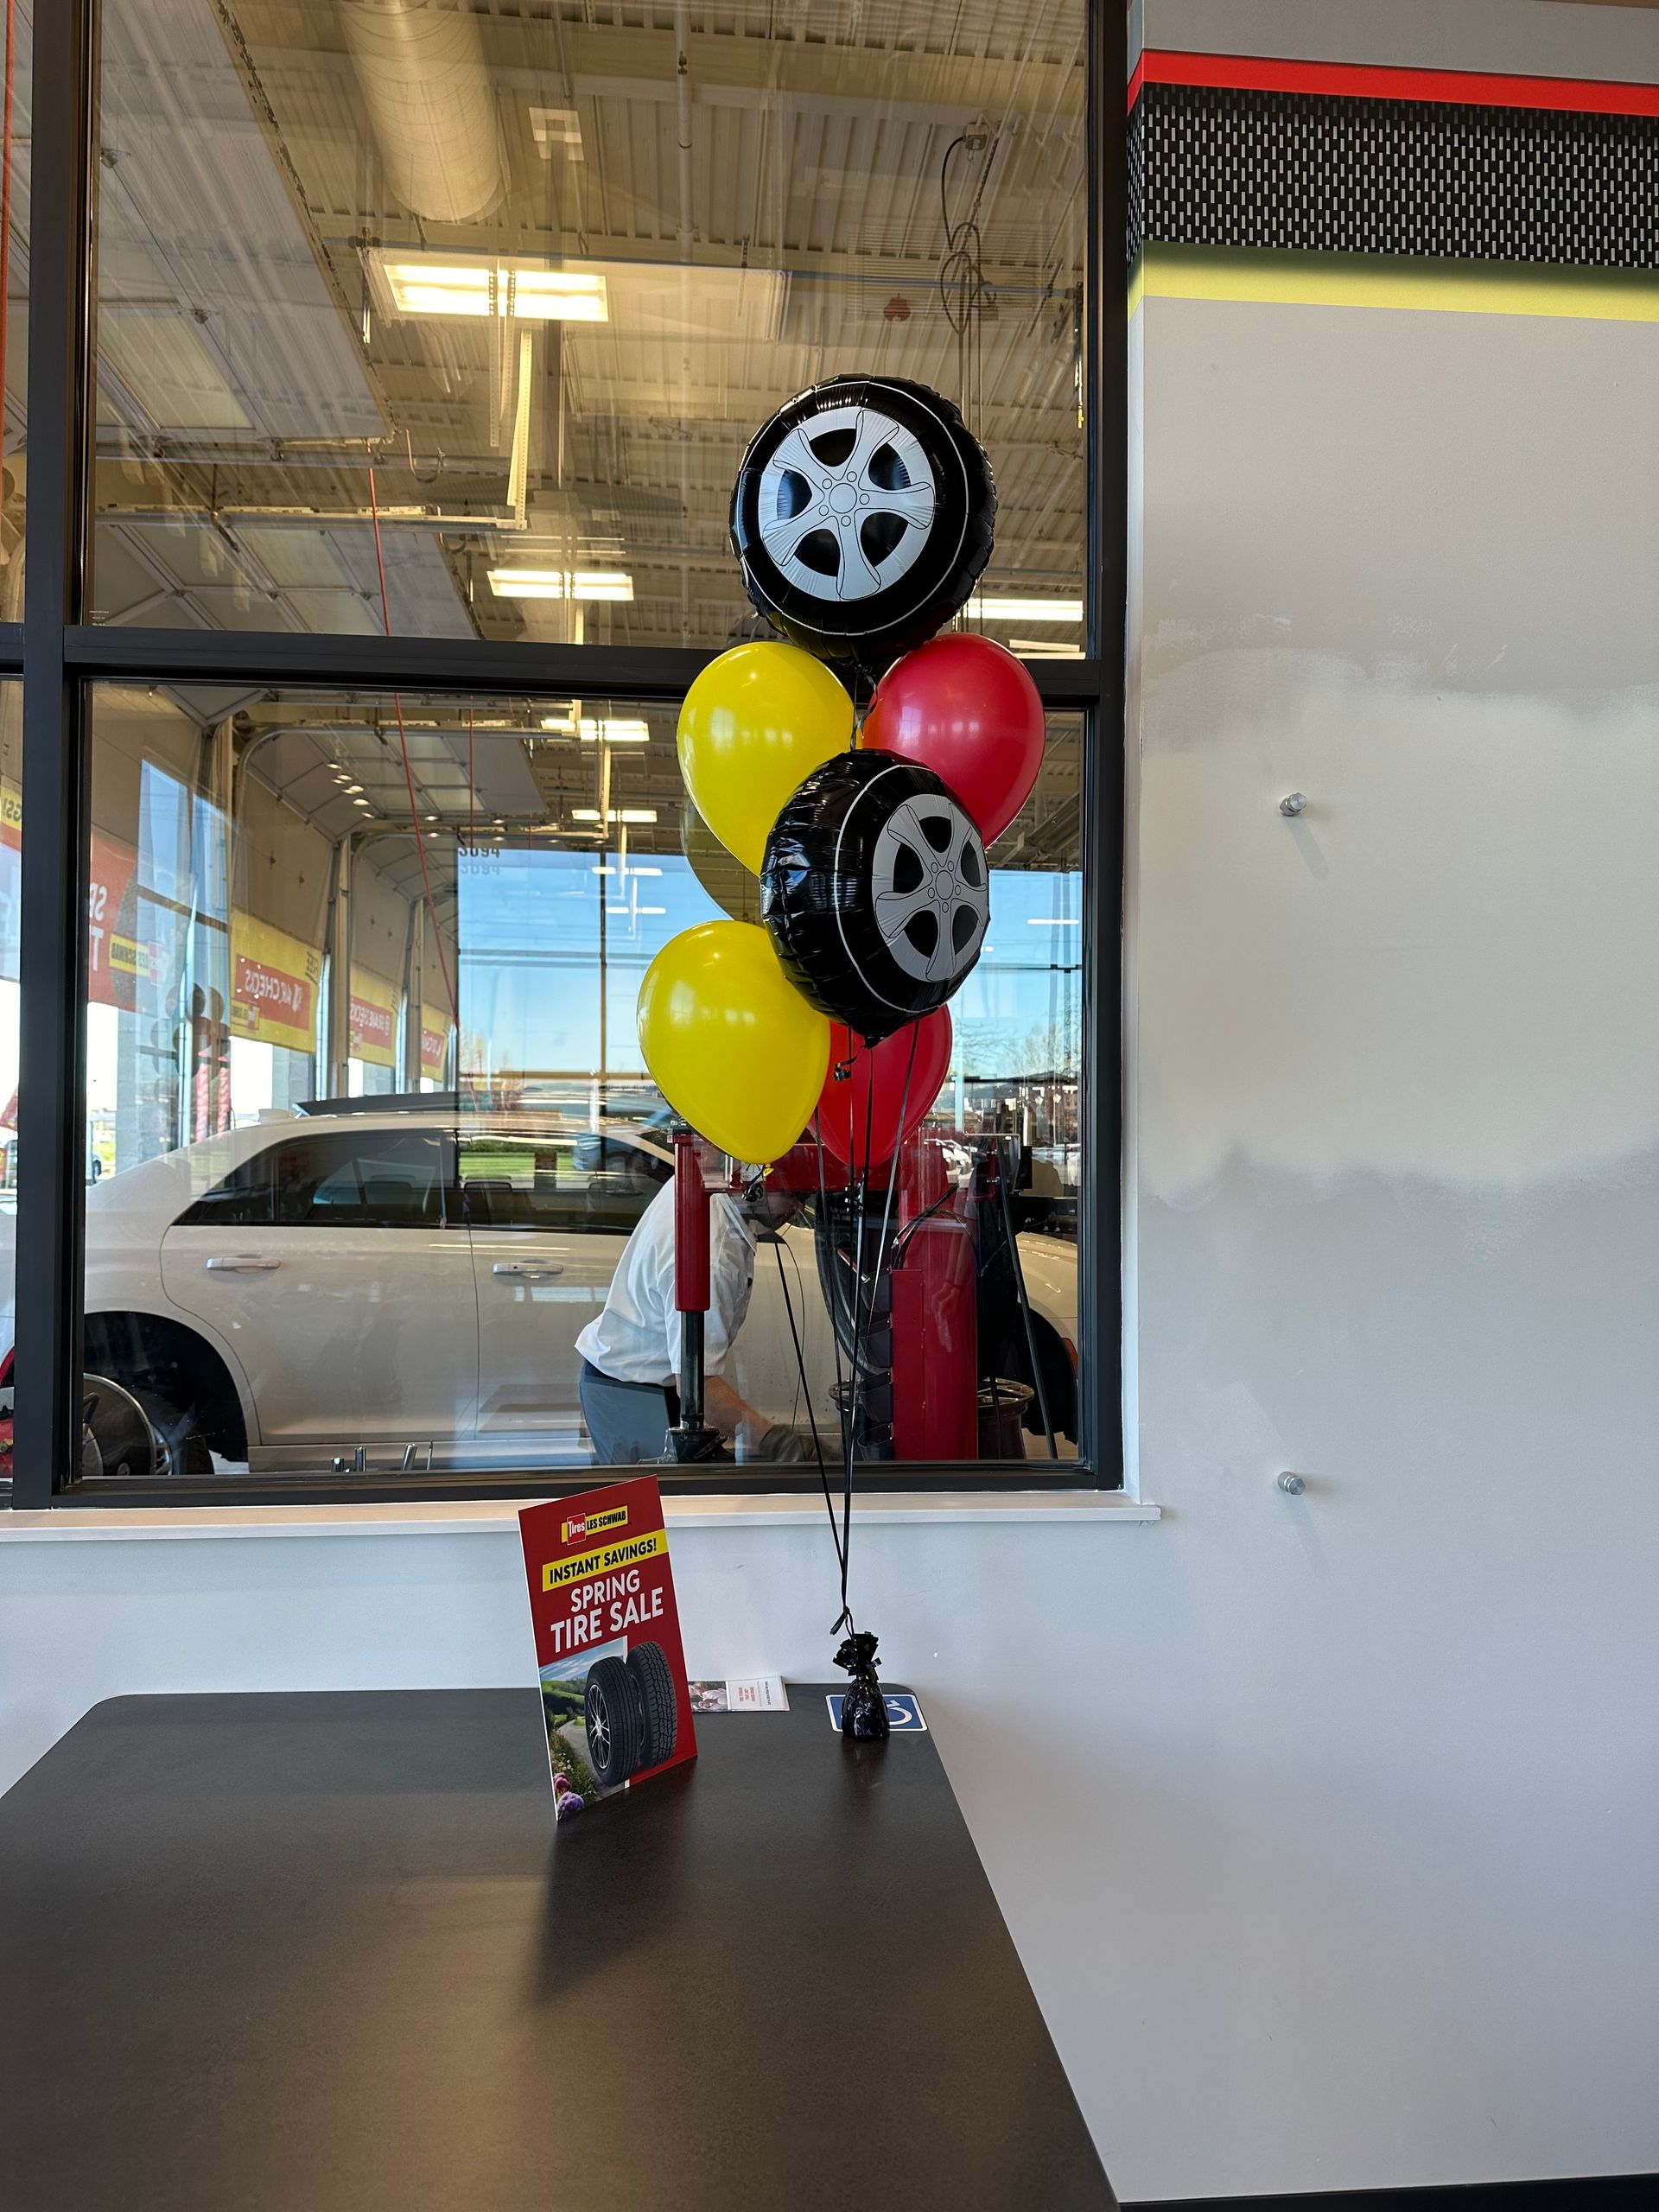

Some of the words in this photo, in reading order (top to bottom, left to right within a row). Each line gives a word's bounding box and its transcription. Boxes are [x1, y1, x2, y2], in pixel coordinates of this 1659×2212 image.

[569, 1521, 585, 1538] Tires
[587, 1518, 598, 1530] LES
[599, 1510, 626, 1527] SCHWAB
[550, 1555, 601, 1584] INSTANT
[604, 1538, 657, 1567] SAVINGS!
[571, 1569, 639, 1612] SPRING
[550, 1607, 602, 1654] TIRE
[609, 1586, 664, 1632] SALE
